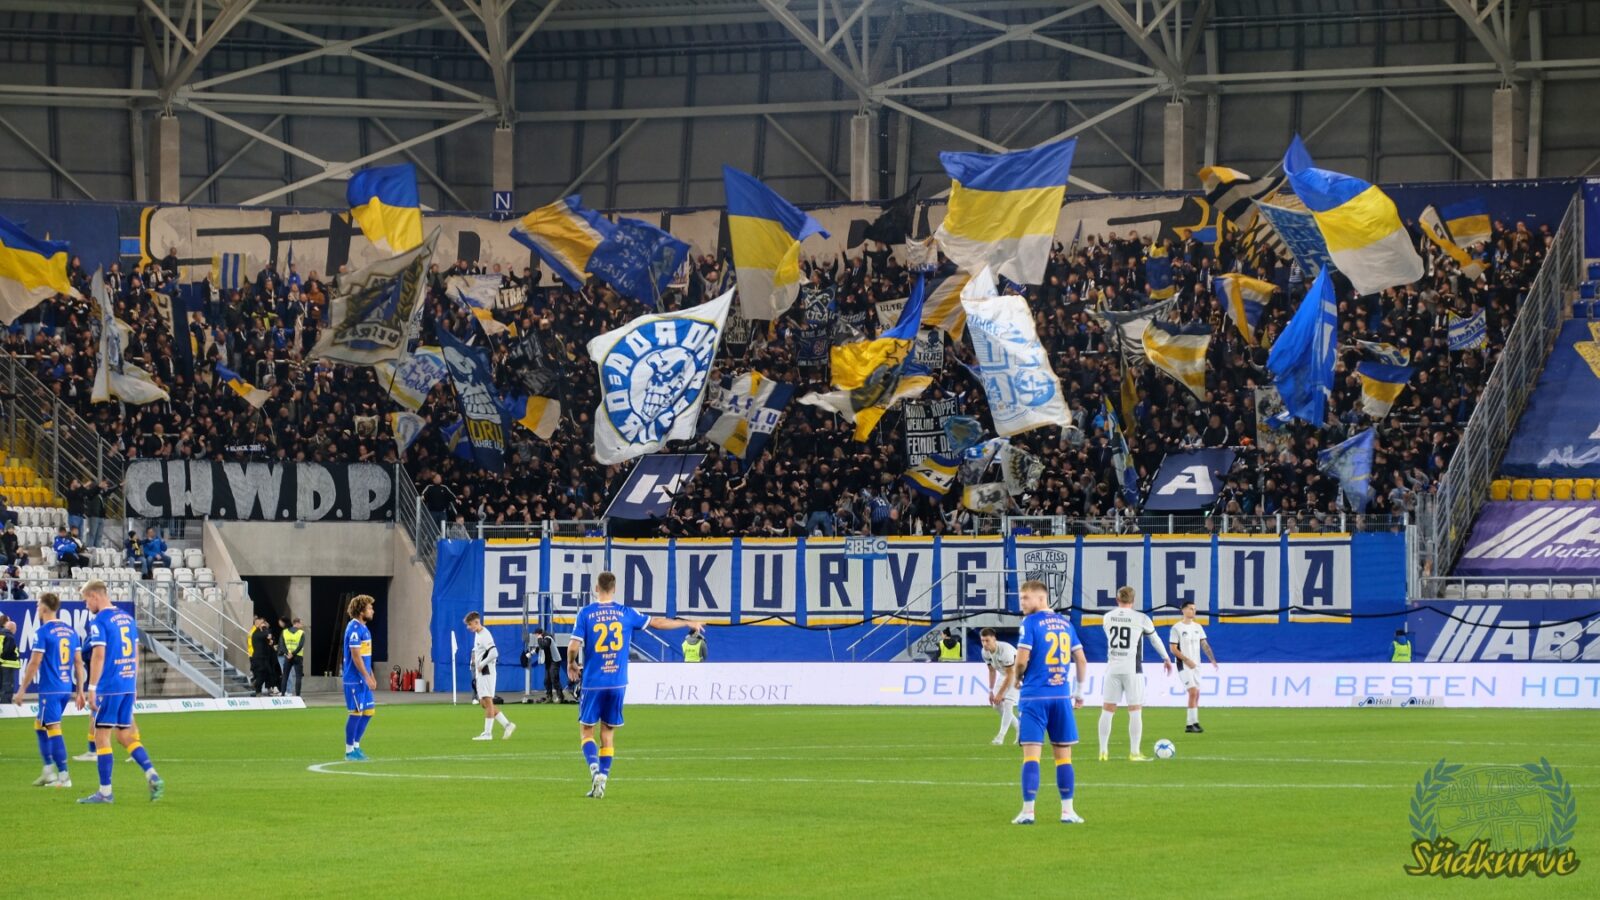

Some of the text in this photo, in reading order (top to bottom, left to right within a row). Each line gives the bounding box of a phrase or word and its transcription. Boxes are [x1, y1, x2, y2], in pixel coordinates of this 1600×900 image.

[496, 193, 509, 209] N
[1157, 466, 1214, 494] A
[846, 538, 887, 554] 3850
[1027, 551, 1065, 562] CARL ZEISS
[1531, 544, 1600, 559] Nutz
[1097, 550, 1333, 607] JENA
[120, 626, 133, 657] 5
[593, 621, 623, 653] 23
[1045, 631, 1071, 664] 29
[1110, 625, 1131, 649] 29
[59, 637, 70, 665] 6
[903, 675, 991, 696] DEIN
[1272, 676, 1311, 697] IM
[1335, 676, 1496, 697] BESTEN
